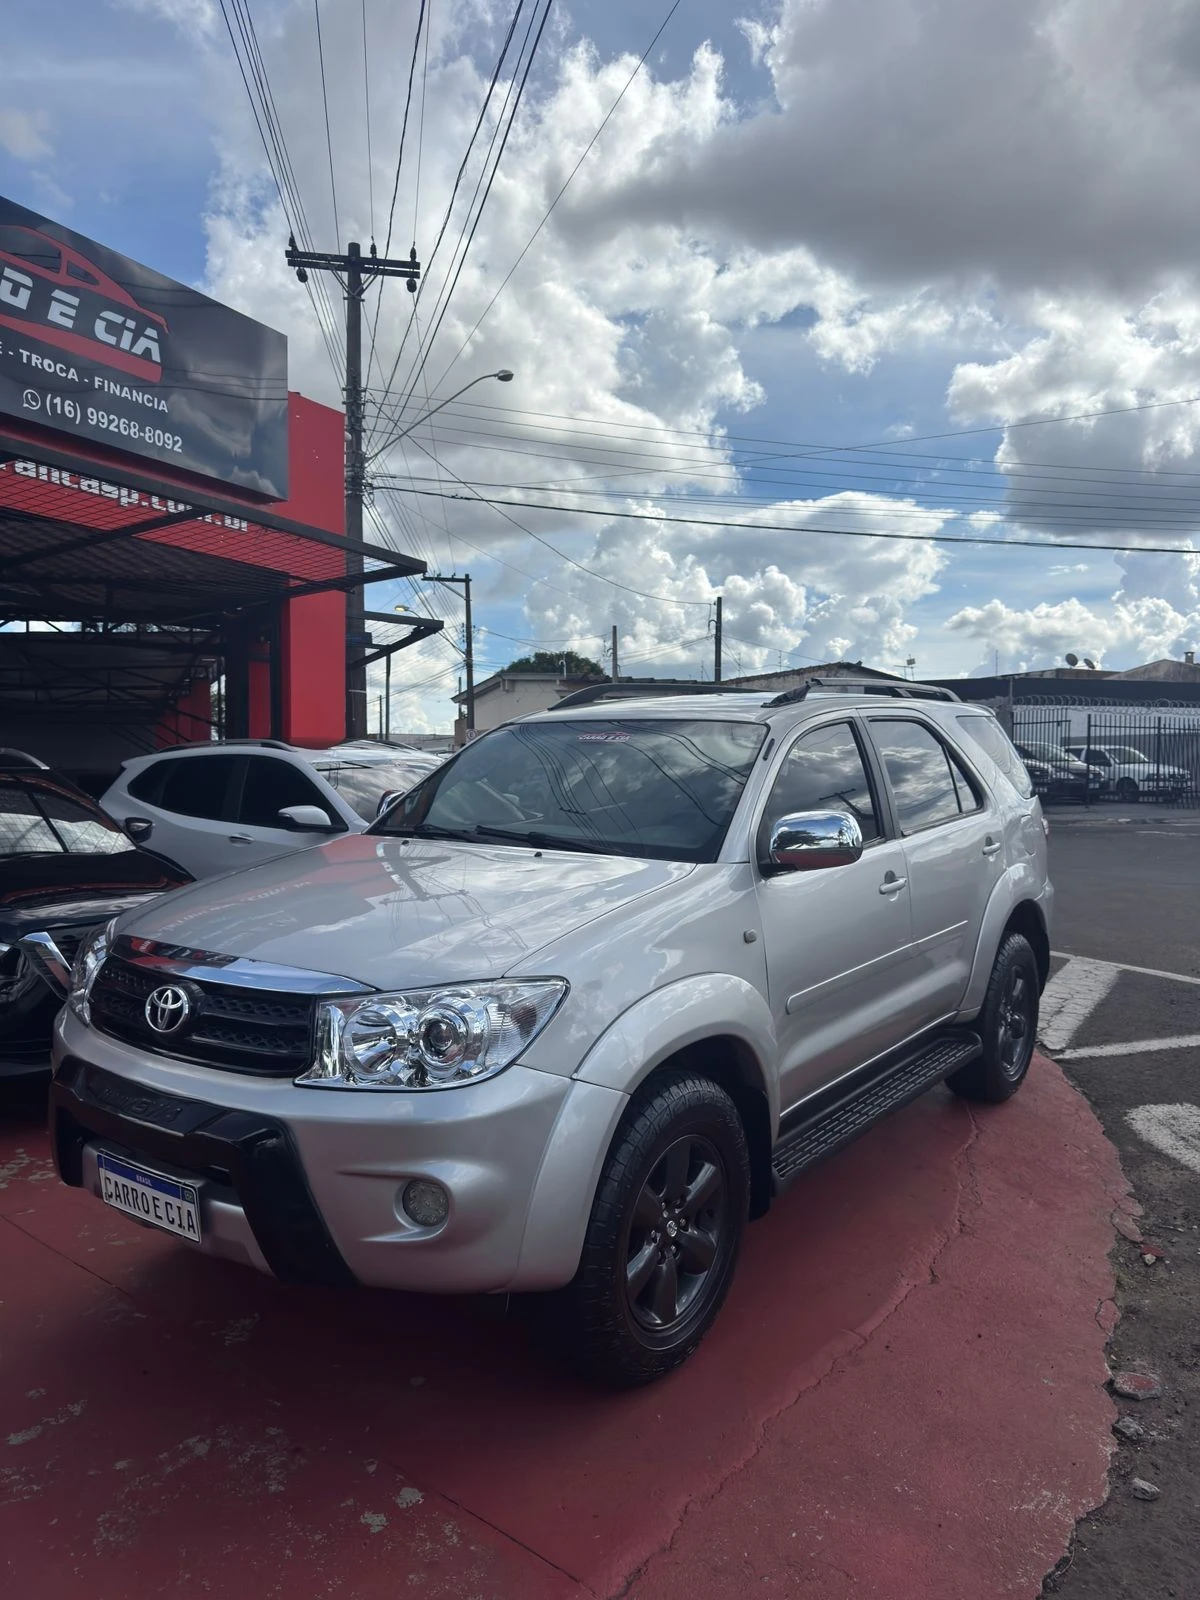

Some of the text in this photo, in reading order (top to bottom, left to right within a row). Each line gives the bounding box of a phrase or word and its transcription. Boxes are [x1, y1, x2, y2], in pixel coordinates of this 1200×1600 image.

[47, 289, 80, 329] E
[19, 349, 79, 382] TROCA
[94, 376, 168, 413] FINANCIA
[46, 394, 183, 453] (16) 99268-8092
